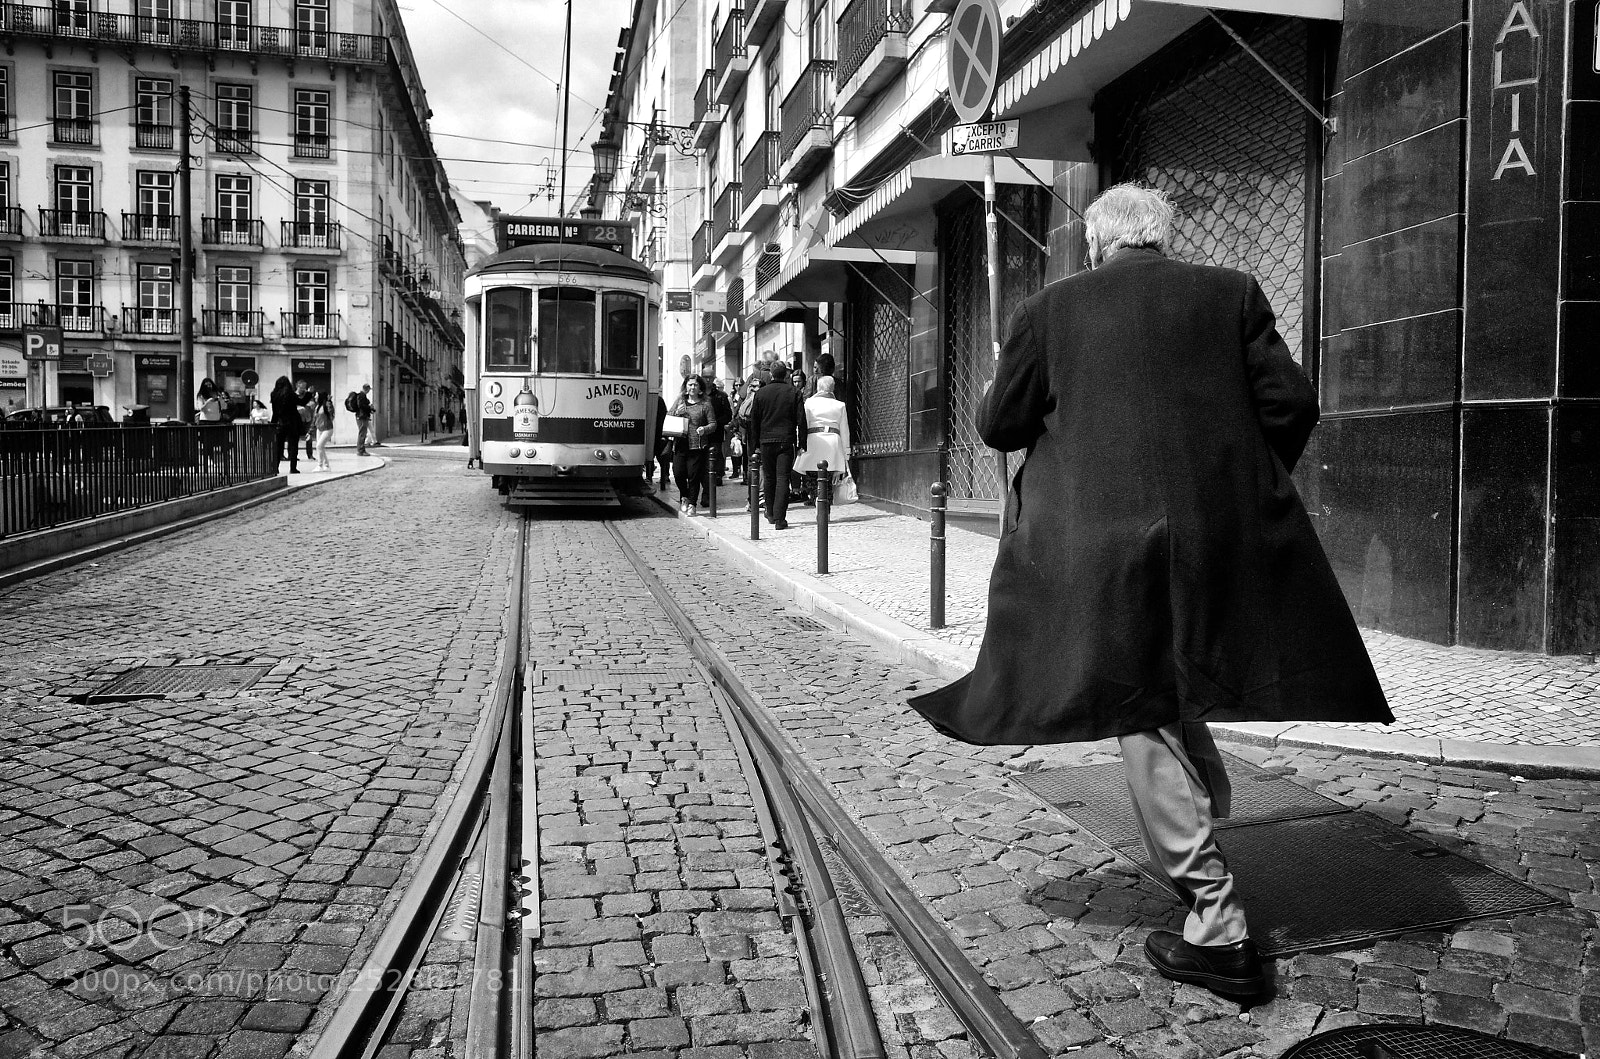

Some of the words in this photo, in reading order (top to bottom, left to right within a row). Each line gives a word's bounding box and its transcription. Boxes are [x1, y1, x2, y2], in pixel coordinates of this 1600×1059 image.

[969, 136, 1002, 151] CARRIS
[507, 223, 560, 237] CARREIRA
[594, 226, 617, 241] 28
[720, 314, 739, 333] M
[26, 334, 44, 356] P
[585, 383, 640, 401] JAMESON
[593, 420, 635, 429] CASKMATES
